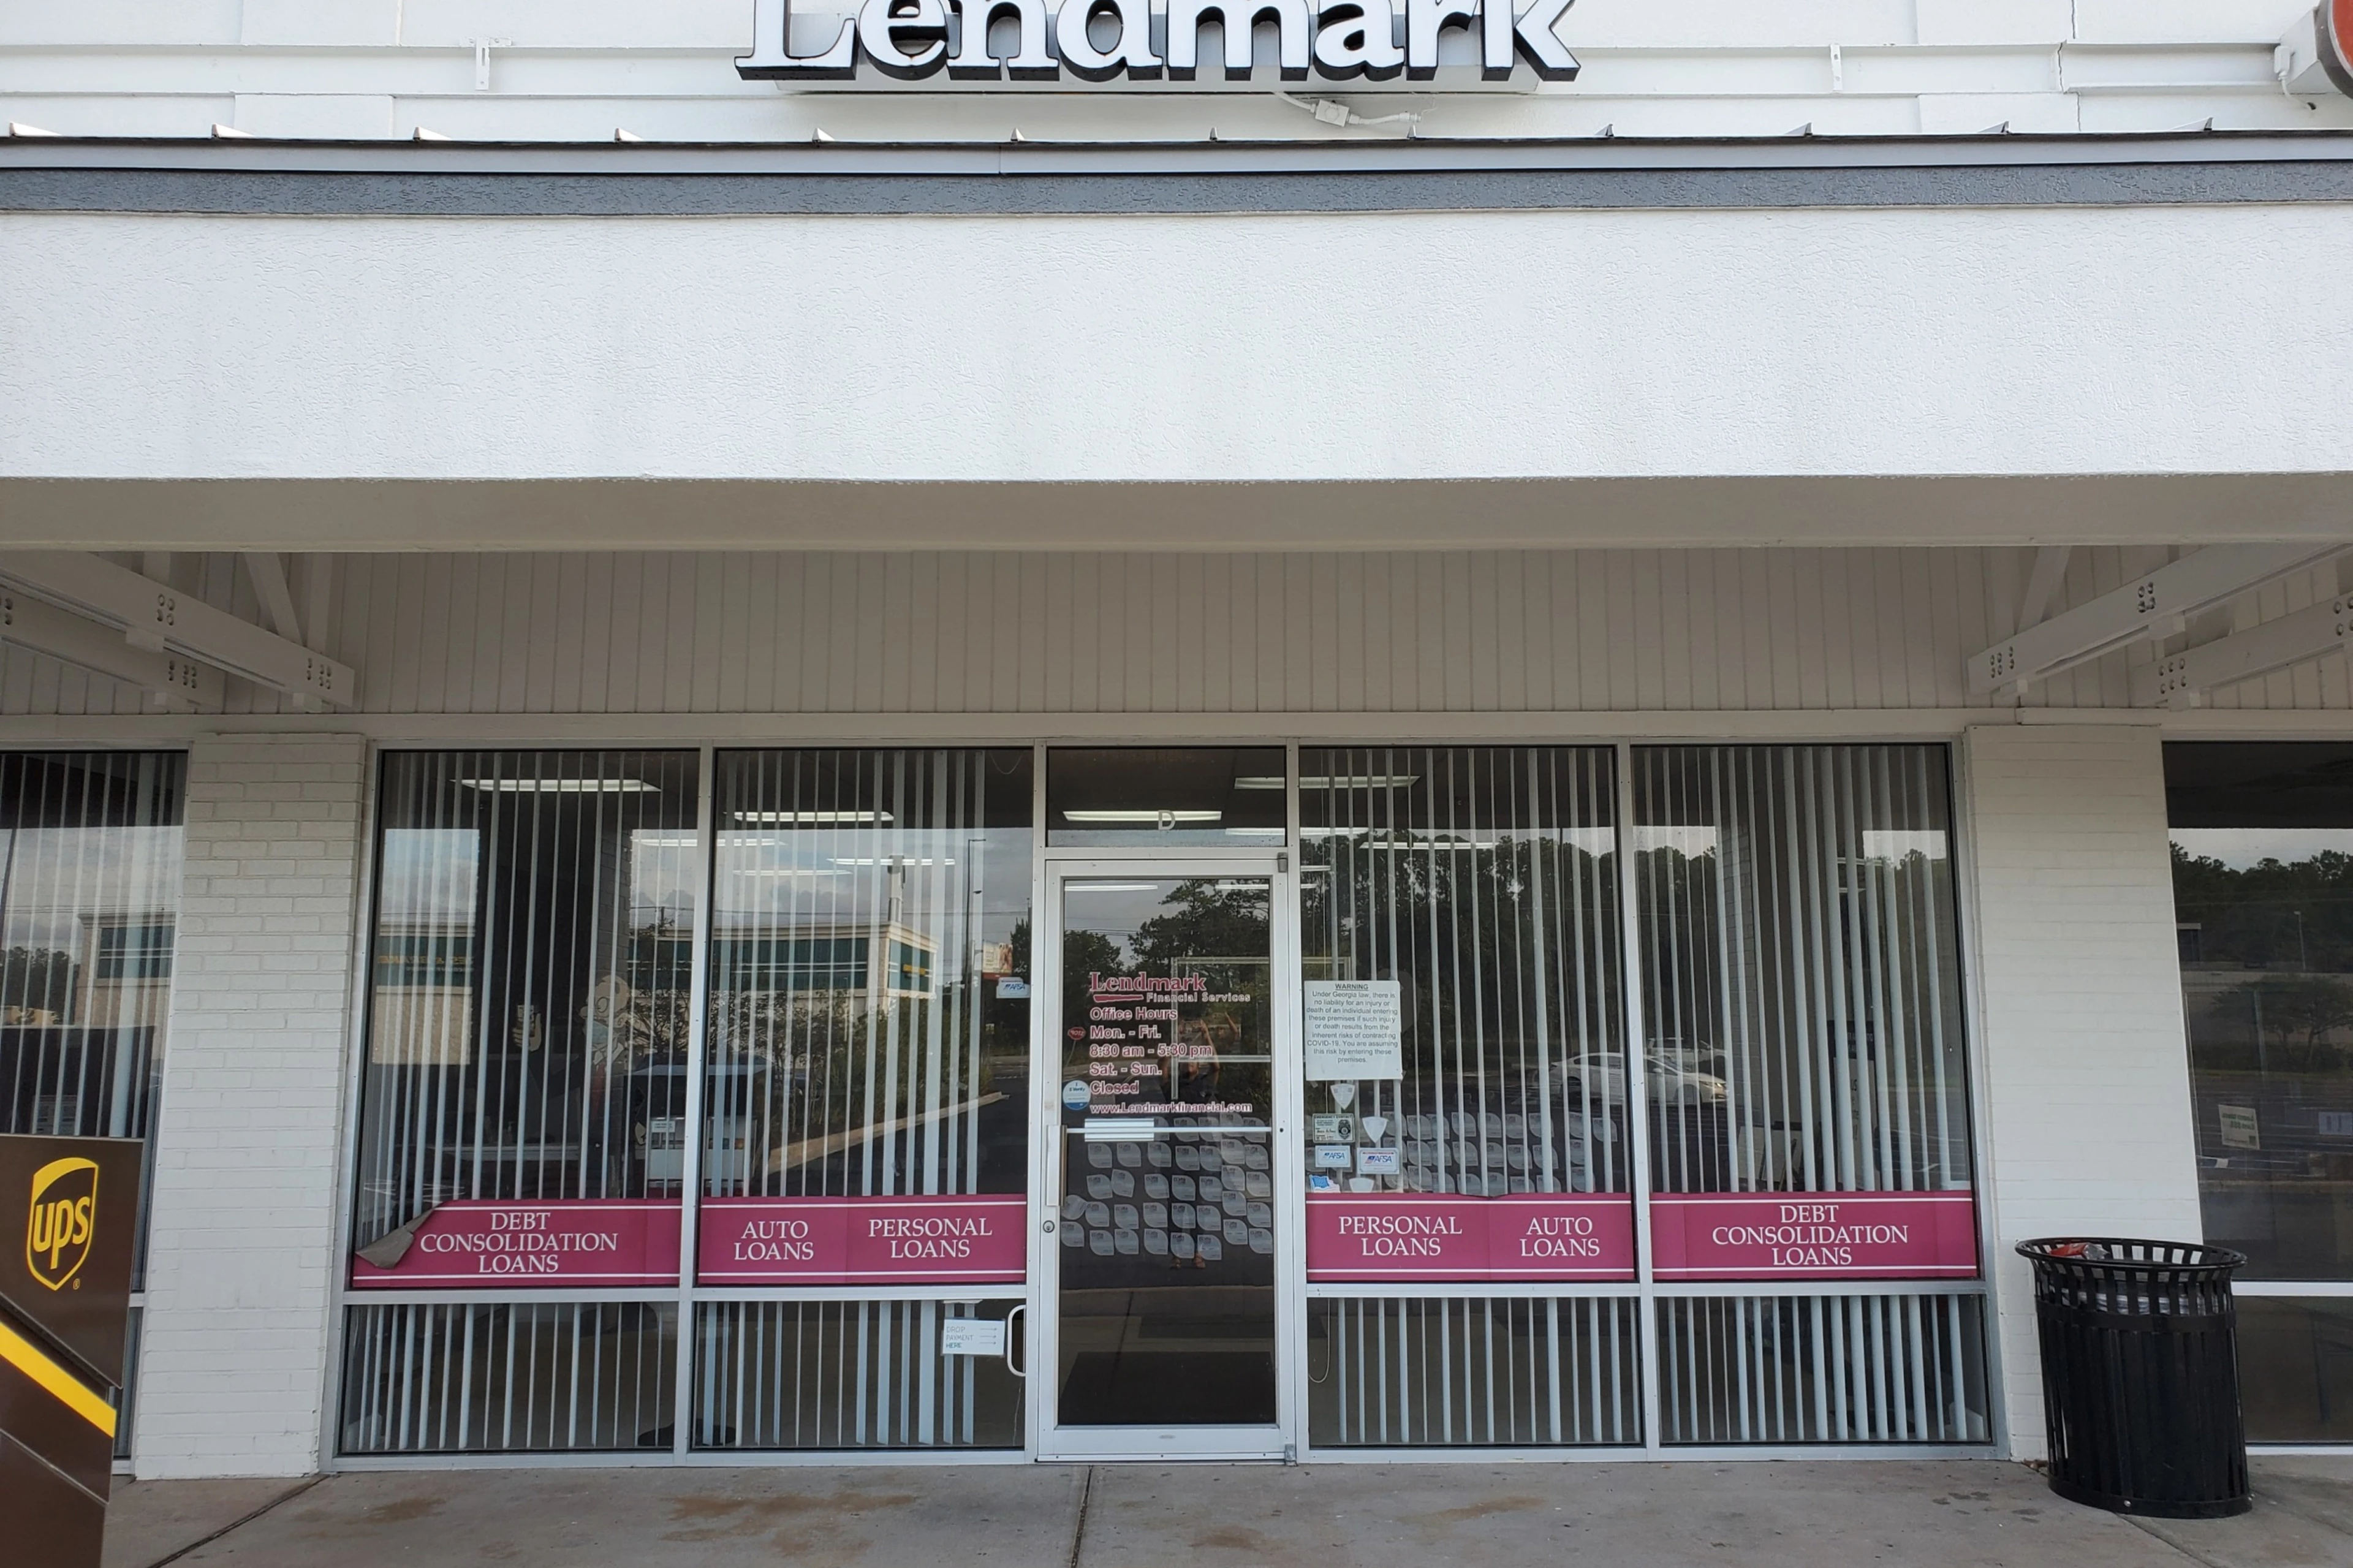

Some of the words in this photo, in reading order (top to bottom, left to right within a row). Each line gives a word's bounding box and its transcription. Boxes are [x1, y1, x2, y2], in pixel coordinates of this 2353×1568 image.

[737, 0, 1580, 81] Lendmark
[1158, 809, 1175, 830] D
[1089, 972, 1207, 991] Lendmark
[1146, 992, 1197, 1002] Financial
[1202, 993, 1251, 1002] Services
[1090, 1007, 1132, 1020] Office
[1135, 1007, 1178, 1020] Hours
[1090, 1025, 1125, 1039] Mon.
[1139, 1025, 1161, 1039] Fri.
[1089, 1043, 1120, 1057] 8:30
[1122, 1047, 1144, 1056] am
[1157, 1043, 1187, 1056] 5:30
[1190, 1046, 1213, 1058] pm
[1089, 1062, 1118, 1075] Sat.
[1131, 1062, 1162, 1075] Sun.
[1090, 1081, 1139, 1094] Closed
[1090, 1102, 1252, 1114] www.Lendmarkfinancial.com
[490, 1212, 551, 1231] DEBT
[1779, 1205, 1839, 1224] DEBT
[32, 1196, 90, 1270] ups
[741, 1221, 809, 1240] AUTO
[868, 1218, 993, 1238] PERSONAL
[1338, 1216, 1463, 1235] PERSONAL
[1526, 1216, 1593, 1235] AUTO
[1712, 1225, 1908, 1245] CONSOLIDATION
[420, 1233, 618, 1253] CONSOLIDATION
[734, 1242, 814, 1261] LOANS
[890, 1240, 971, 1259] LOANS
[1361, 1237, 1441, 1257] LOANS
[1520, 1238, 1600, 1257] LOANS
[479, 1254, 559, 1274] LOANS
[1772, 1247, 1852, 1266] LOANS
